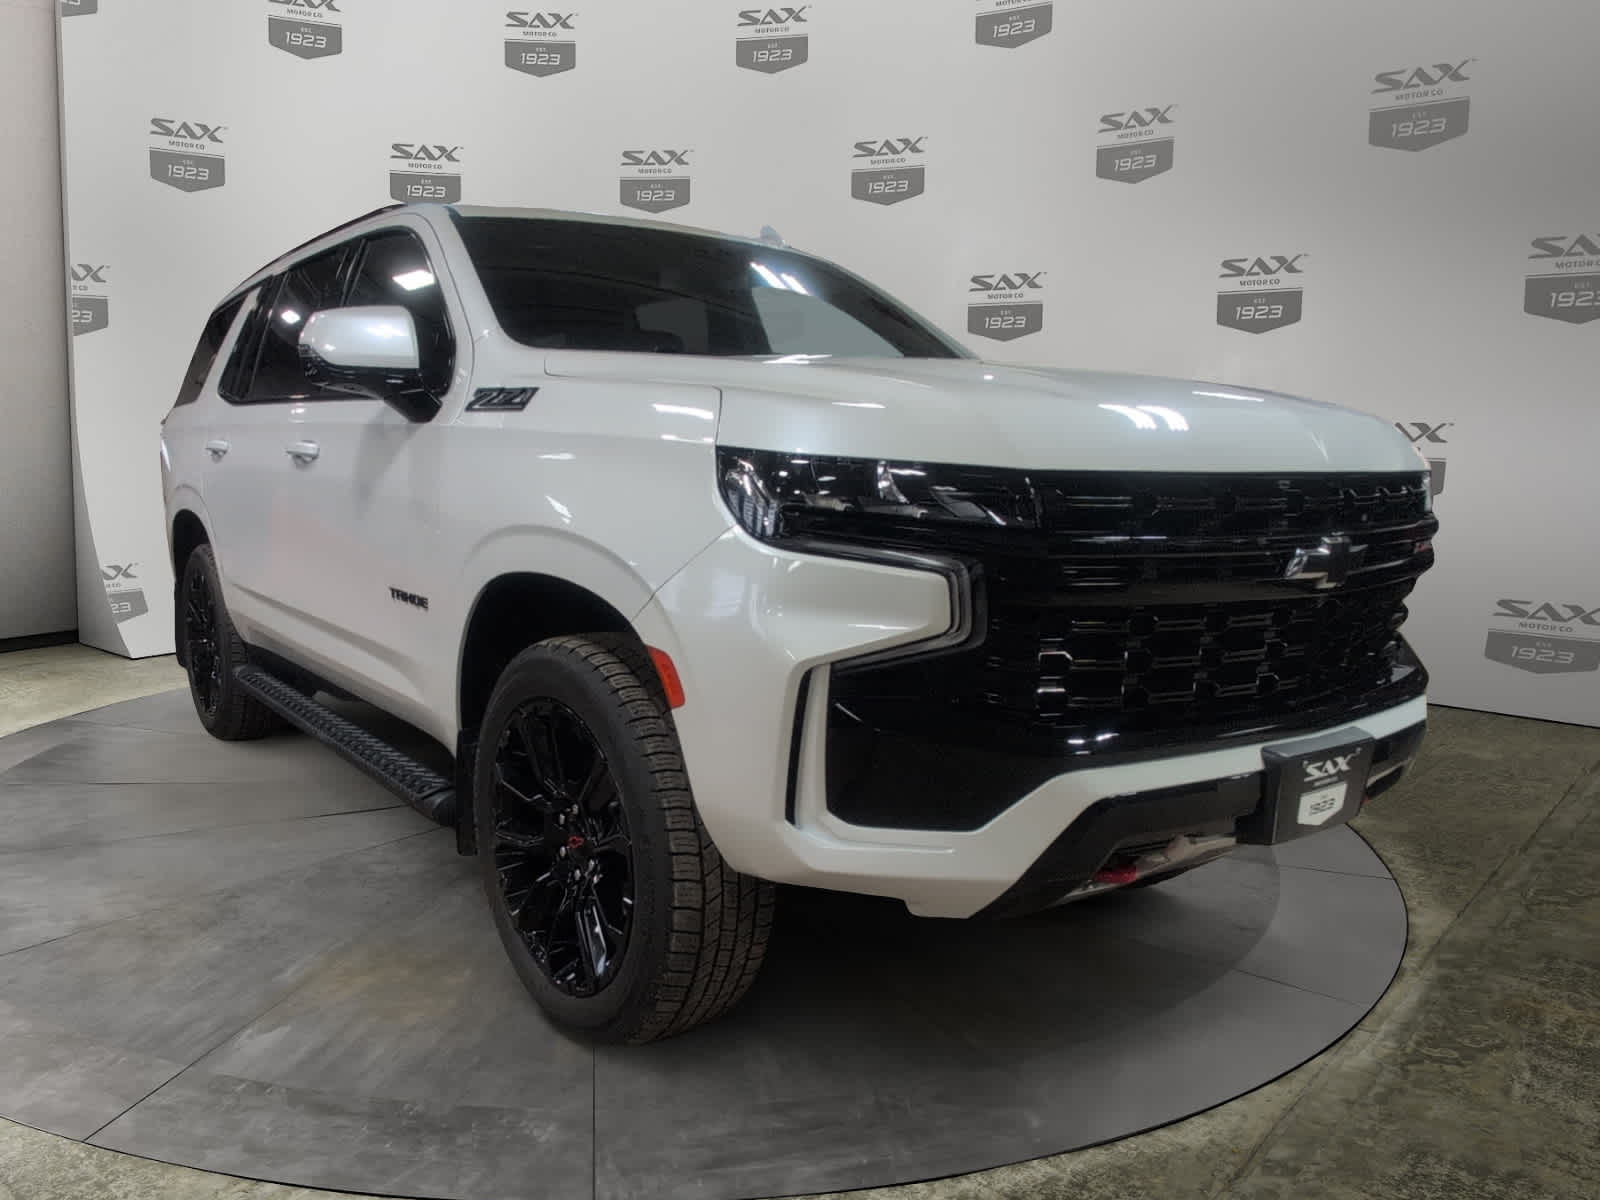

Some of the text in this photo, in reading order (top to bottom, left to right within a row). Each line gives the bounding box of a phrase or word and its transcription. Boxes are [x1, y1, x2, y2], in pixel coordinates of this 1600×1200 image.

[504, 11, 575, 29] SAX
[737, 6, 807, 27] SAX
[992, 20, 1036, 38] 1923
[285, 32, 327, 48] 1923
[520, 52, 561, 65] 1923
[752, 49, 792, 62] 1923
[1370, 59, 1471, 94] SAX
[1098, 105, 1175, 133] SAX
[1391, 118, 1447, 137] 1923
[149, 118, 223, 143] SAX
[390, 143, 460, 162] SAX
[852, 136, 924, 158] SAX
[620, 149, 689, 165] SAX
[1113, 155, 1157, 172] 1923
[167, 164, 210, 180] 1923
[406, 184, 446, 198] 1923
[636, 190, 675, 201] 1923
[868, 180, 909, 193] 1923
[1528, 233, 1600, 259] SA
[1219, 254, 1304, 278] SAX
[969, 271, 1043, 292] SAX
[1550, 291, 1600, 308] 192
[1235, 305, 1283, 320] 1923
[984, 316, 1026, 329] 1923
[1492, 599, 1600, 625] SAX
[1511, 645, 1576, 664] 1923
